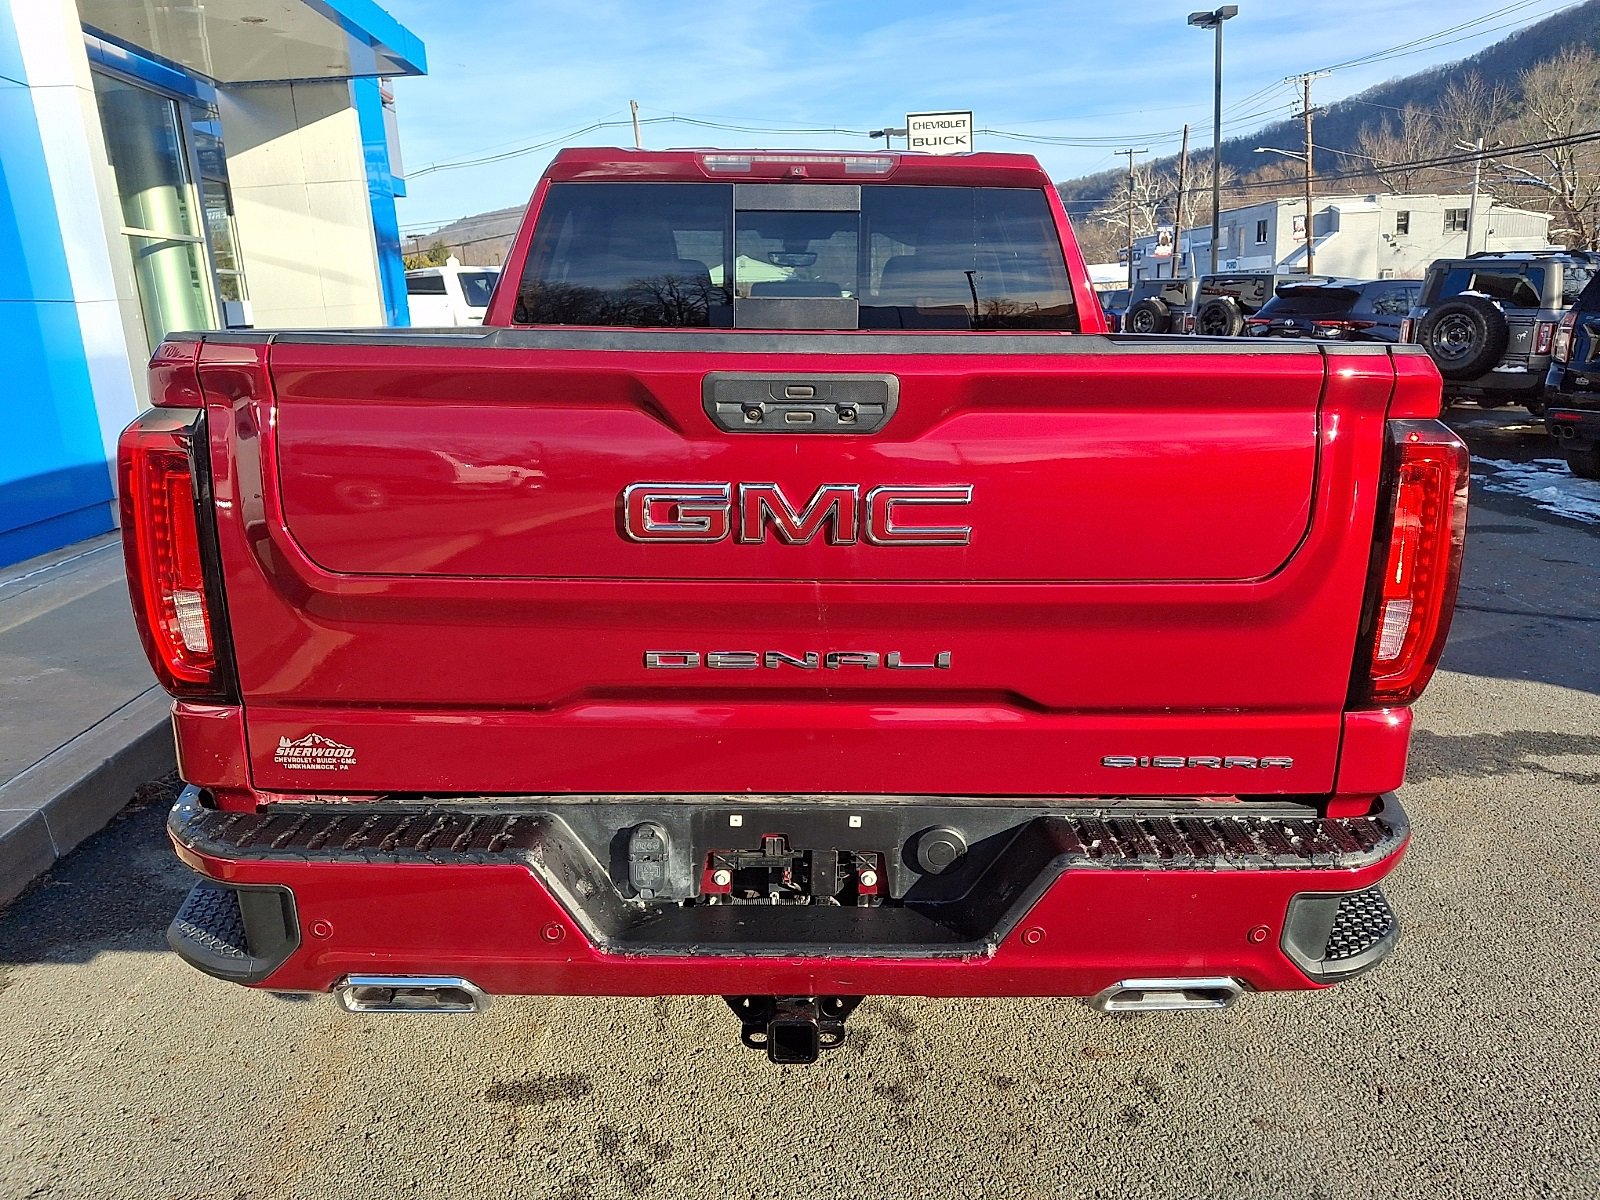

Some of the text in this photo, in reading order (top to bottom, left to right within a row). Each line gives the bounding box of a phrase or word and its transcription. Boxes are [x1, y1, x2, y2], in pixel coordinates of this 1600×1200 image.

[912, 119, 967, 130] CHEVROLET
[912, 135, 967, 147] BUICK
[621, 480, 974, 547] GMC
[644, 649, 952, 670] DENALI
[274, 747, 355, 758] SHERWOOD
[1102, 755, 1294, 769] SIERRA
